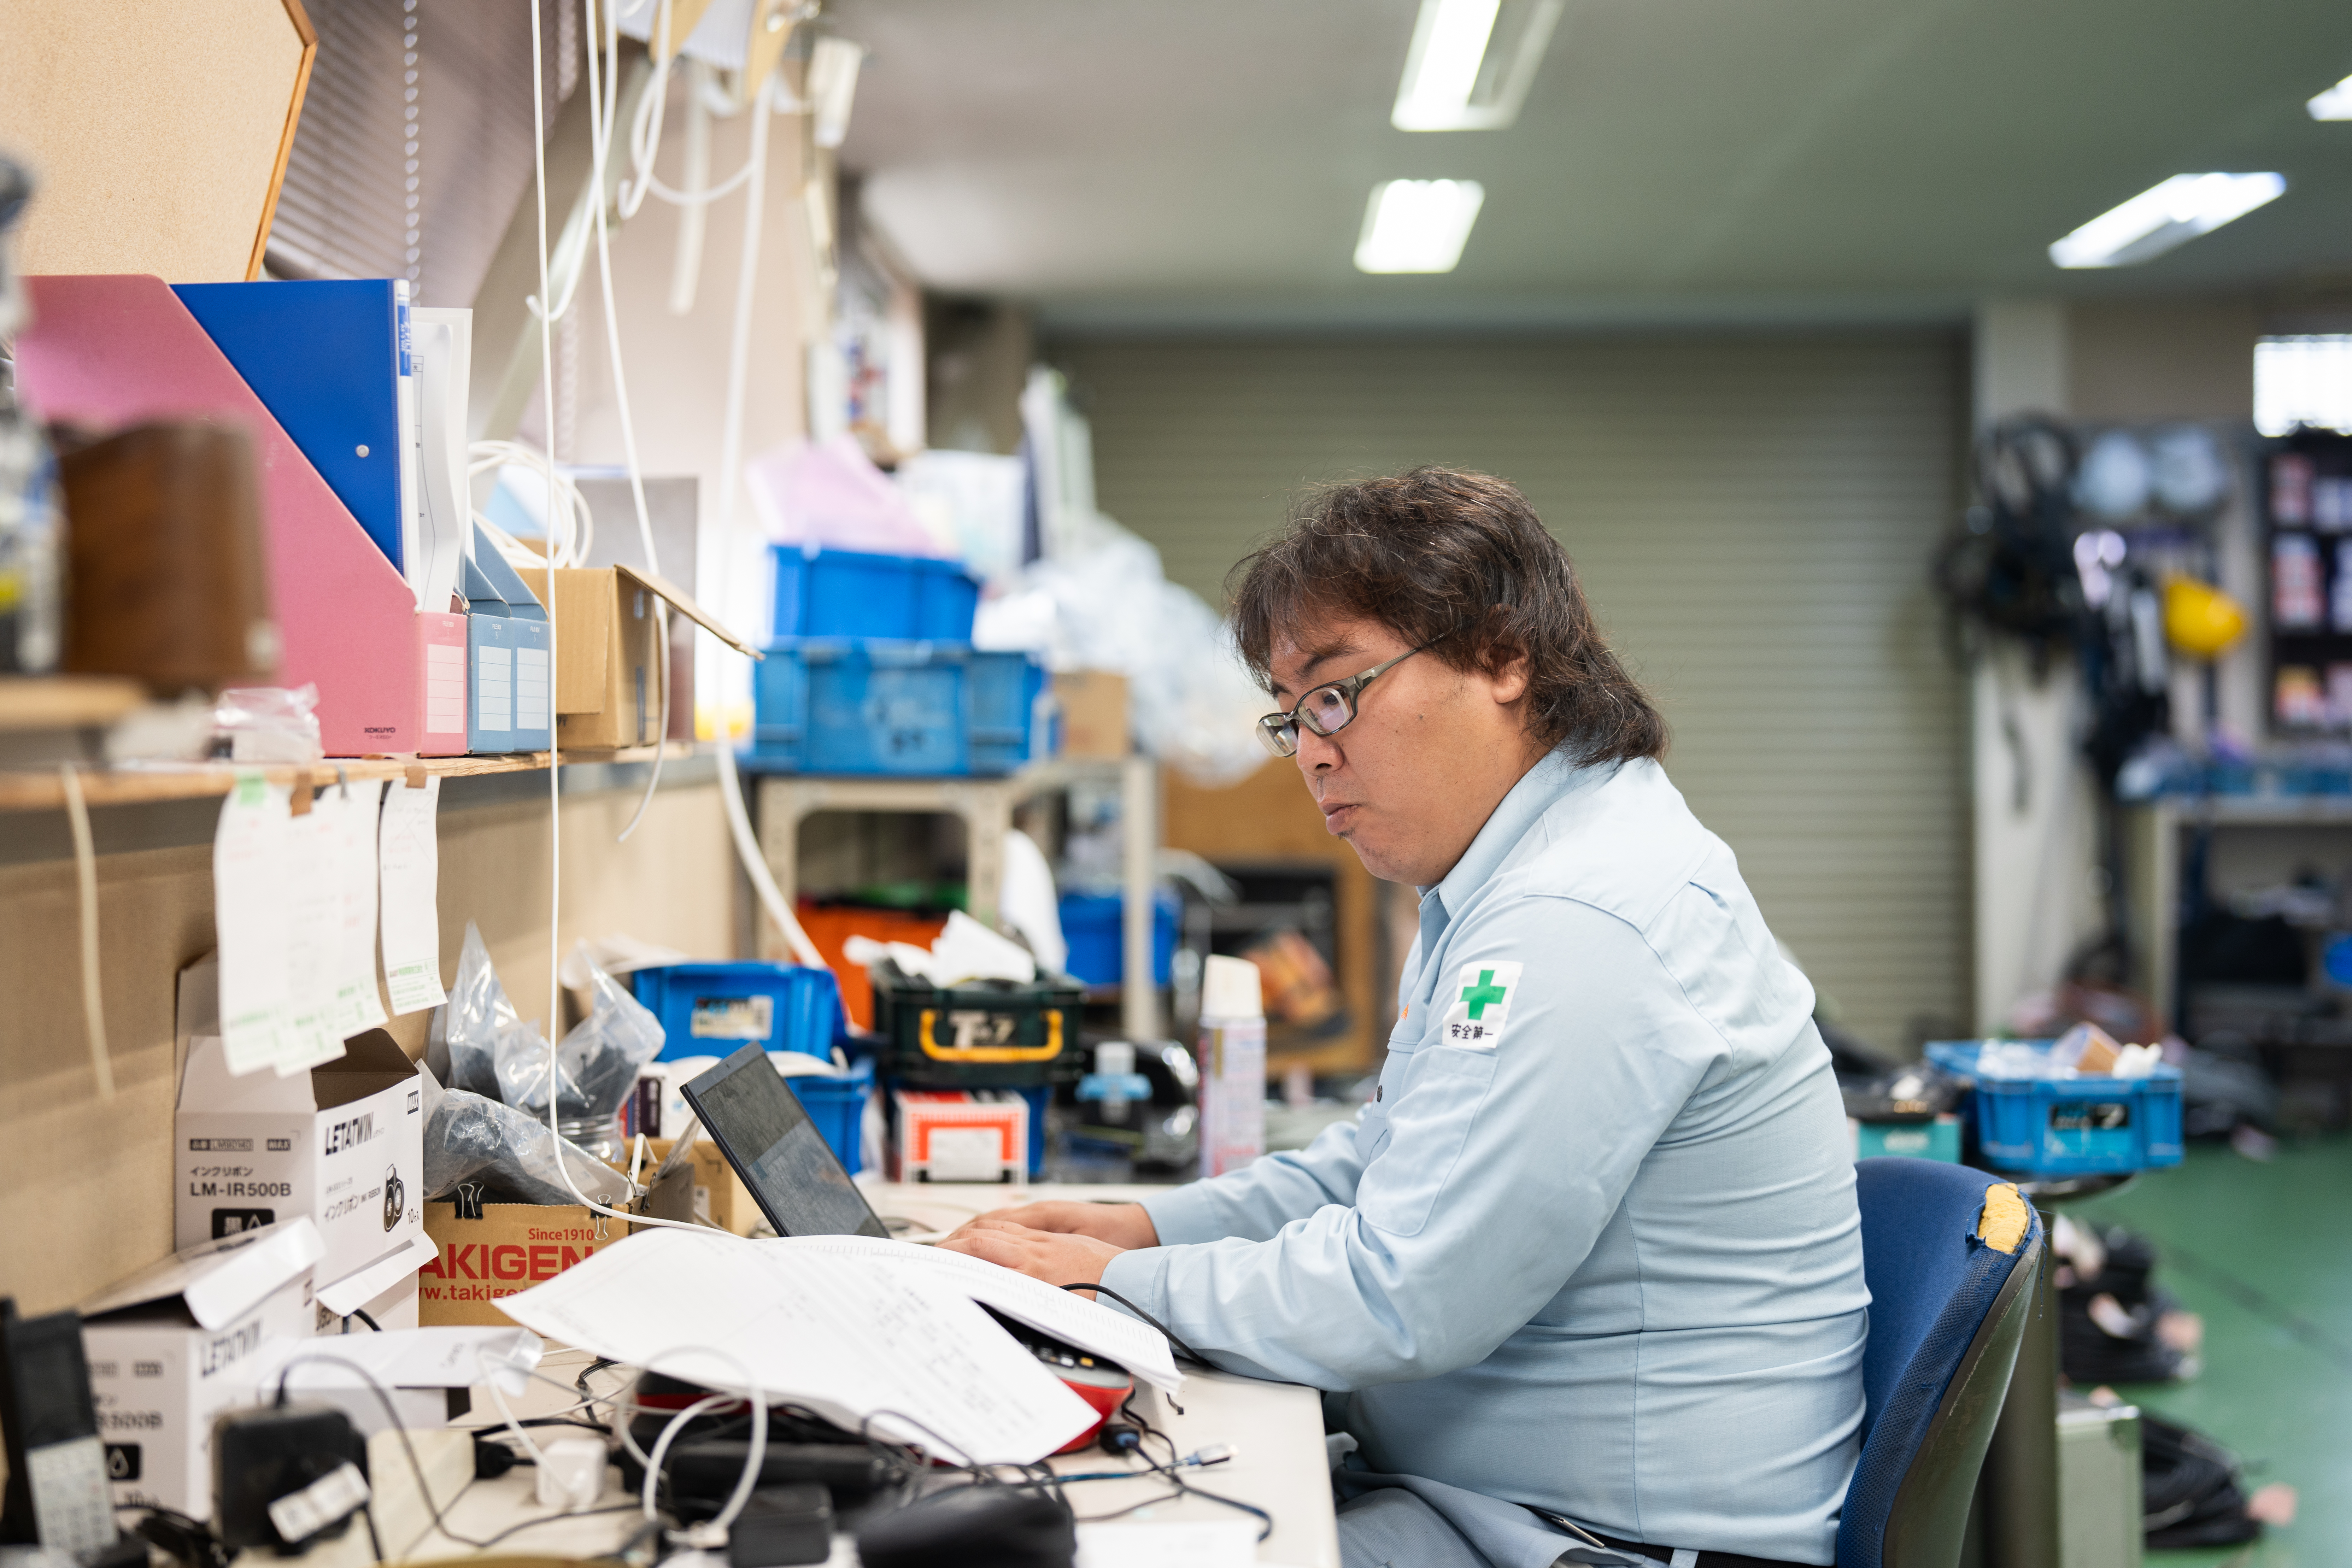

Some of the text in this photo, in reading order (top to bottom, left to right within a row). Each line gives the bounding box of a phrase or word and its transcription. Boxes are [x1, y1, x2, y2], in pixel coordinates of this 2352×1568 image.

[1451, 1024, 1493, 1040] 安全第一
[407, 1094, 419, 1111] MAX
[325, 1111, 374, 1155] LETATWIN
[268, 1140, 290, 1150] MAX
[190, 1182, 291, 1197] LM-IR500B
[529, 1228, 594, 1241] Since1910
